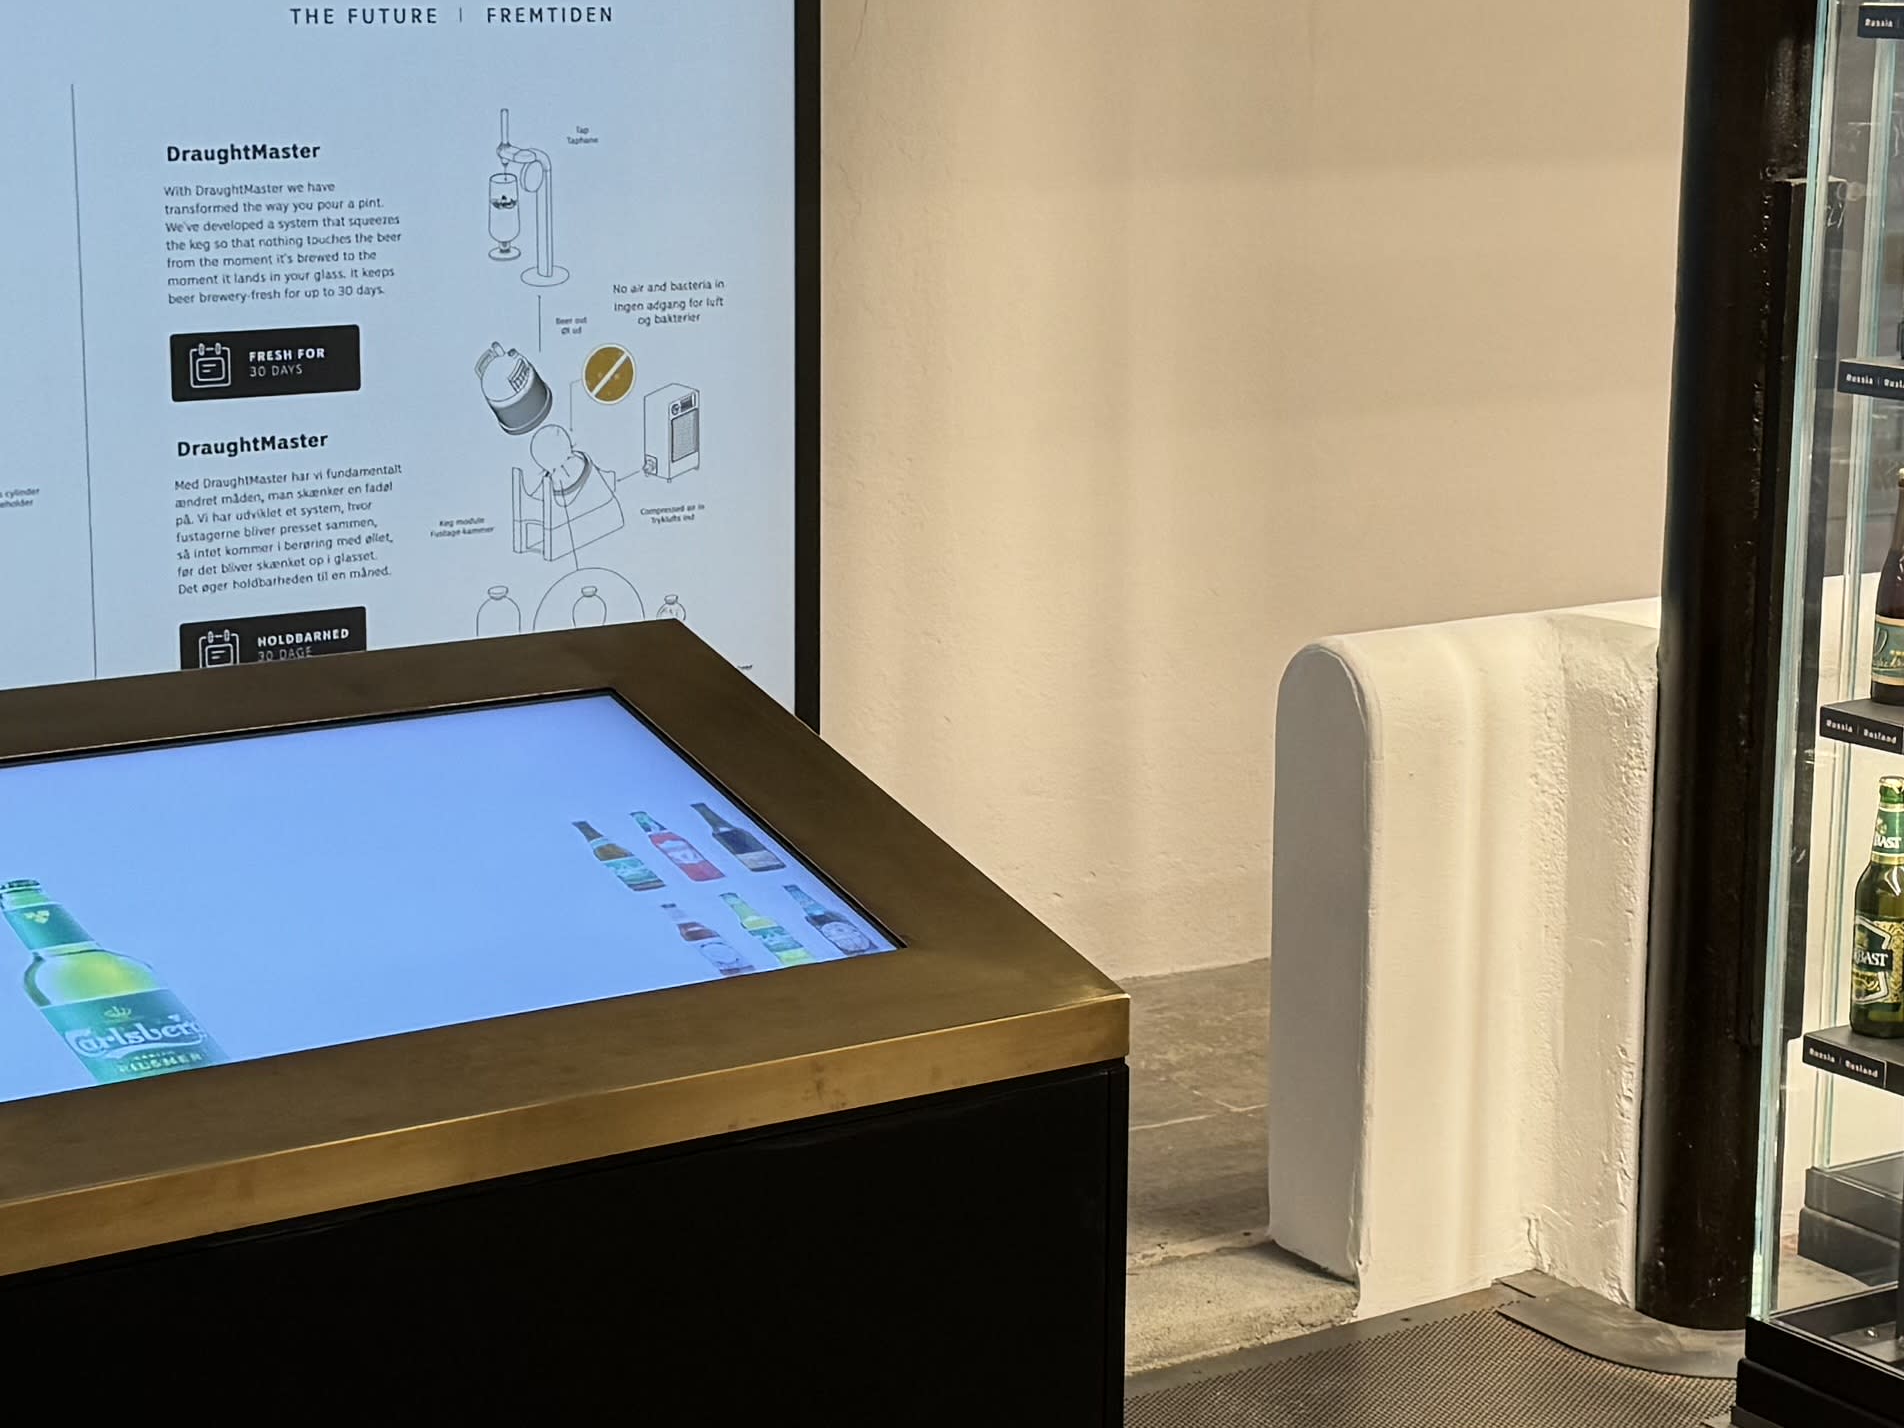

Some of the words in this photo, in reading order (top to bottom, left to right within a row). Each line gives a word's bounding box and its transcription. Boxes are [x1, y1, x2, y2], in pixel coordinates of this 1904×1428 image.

[289, 7, 334, 26] THE
[348, 7, 437, 25] FUTURE
[487, 6, 612, 24] FREMTIDEN
[166, 143, 321, 166] DraughtMaster
[167, 293, 196, 305] beer
[284, 287, 301, 300] for
[304, 288, 320, 300] up
[322, 287, 336, 298] to
[337, 285, 354, 297] 30
[249, 349, 293, 362] FRESH
[297, 347, 325, 360] FOR
[249, 365, 267, 378] 30
[271, 363, 303, 377] DAYS
[177, 433, 329, 458] DraughtMaster
[257, 628, 350, 647] HOLDBARHED
